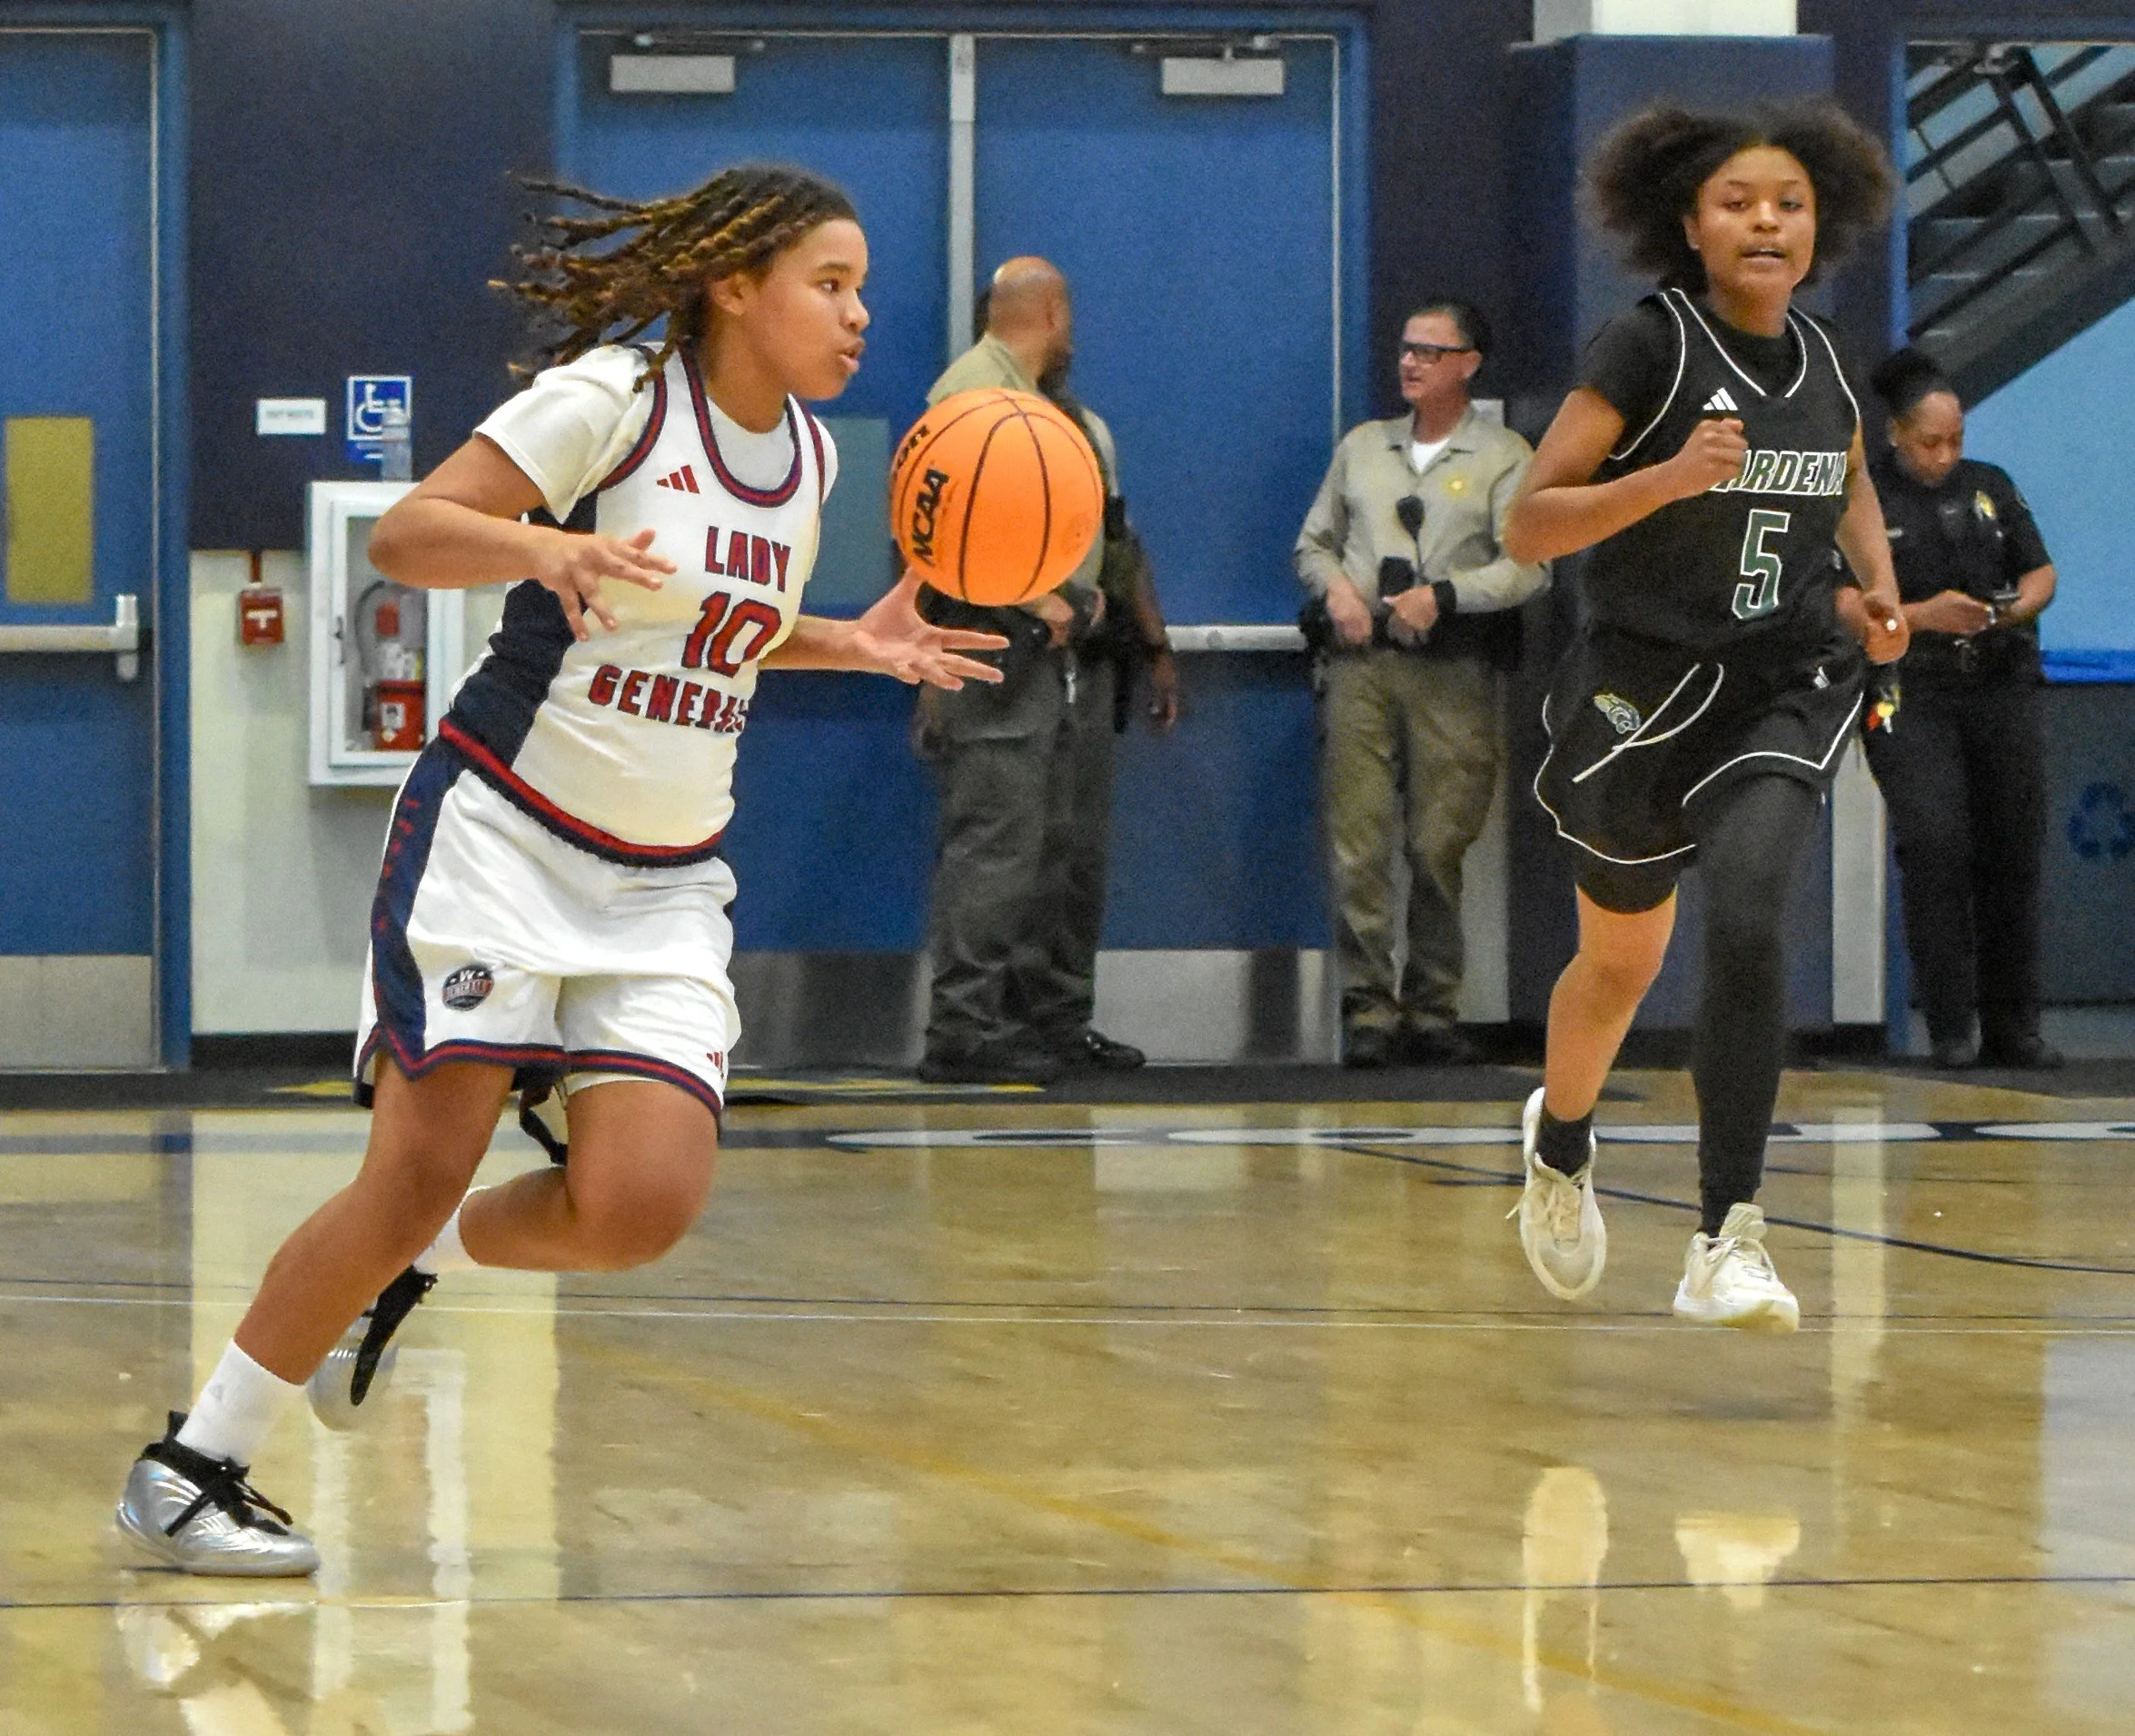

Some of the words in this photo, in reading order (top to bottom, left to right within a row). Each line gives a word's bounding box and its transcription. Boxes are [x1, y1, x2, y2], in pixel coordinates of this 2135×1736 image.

[1708, 449, 1848, 496] RDENA
[704, 525, 791, 592] LADY
[912, 468, 949, 567] NCAA
[1731, 508, 1791, 619] 5
[680, 590, 781, 679] 10
